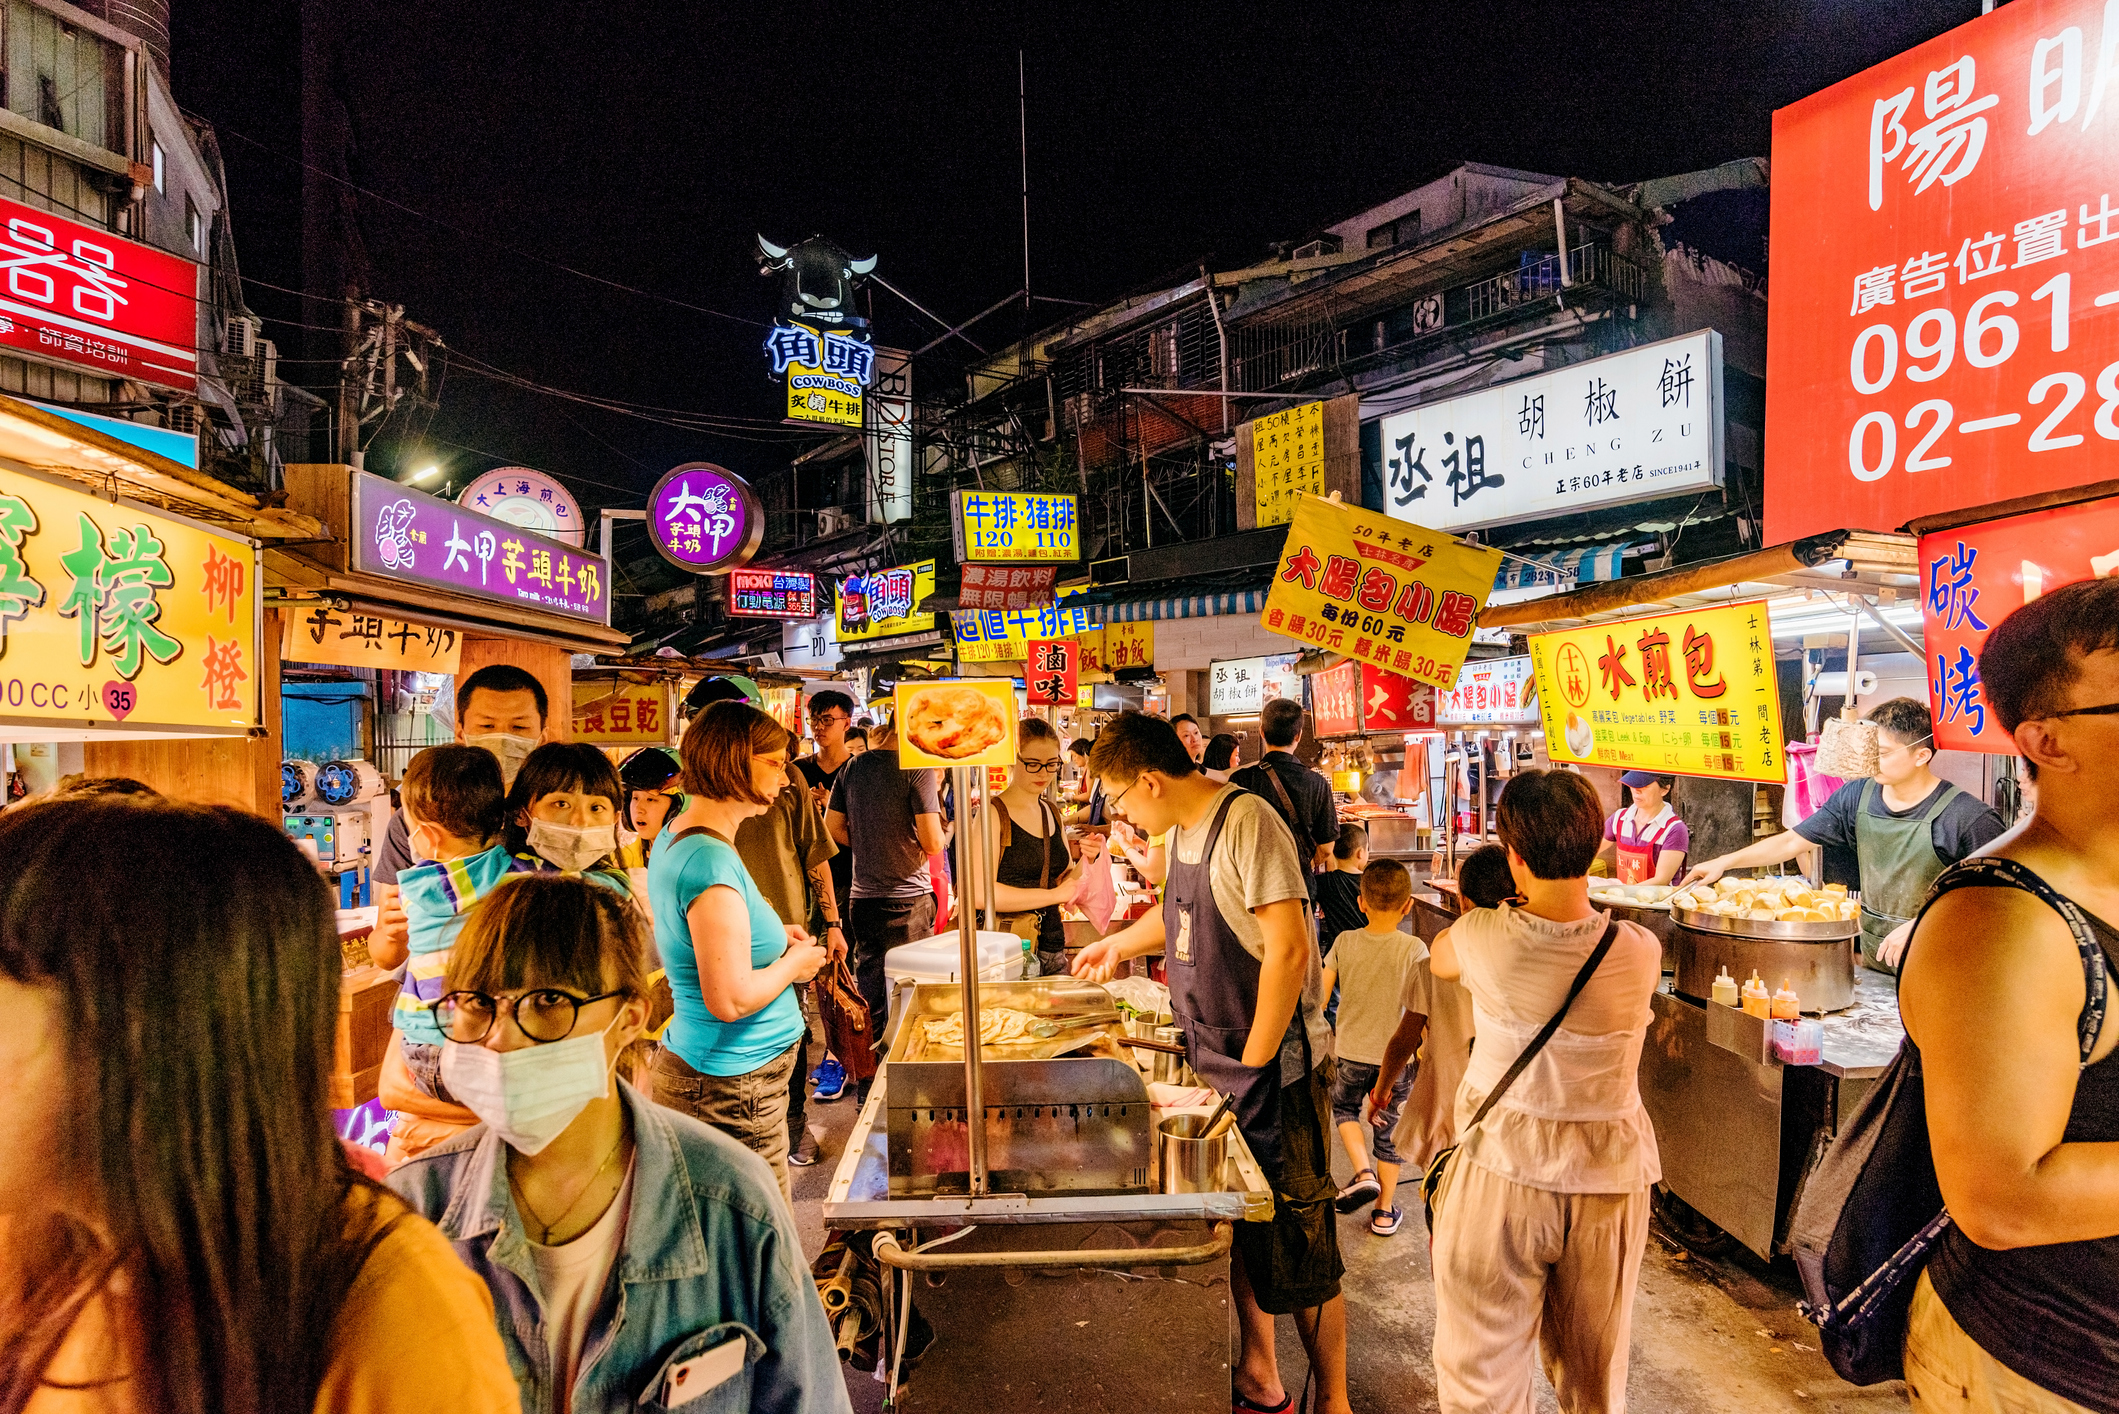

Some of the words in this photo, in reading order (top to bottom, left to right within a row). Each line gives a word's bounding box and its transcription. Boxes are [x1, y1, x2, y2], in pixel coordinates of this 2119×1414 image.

[767, 326, 874, 385] 角頭
[792, 374, 826, 389] COW
[826, 377, 862, 398] BOSS
[1518, 353, 1695, 441] 胡椒餅
[791, 390, 861, 417] 炙燒牛排
[879, 432, 897, 504] STORE
[1388, 431, 1506, 507] 丞祖
[1523, 437, 1622, 470] CHENG
[1555, 464, 1644, 494] 正宗60年老店
[475, 480, 569, 518] 大上海煎包
[664, 479, 736, 556] 大甲
[670, 521, 702, 538] 芋頭
[667, 538, 702, 554] 牛奶
[973, 530, 1014, 548] 120
[1034, 531, 1072, 548] 110
[1352, 524, 1435, 558] 50年老店
[867, 570, 912, 616] 角頭
[963, 565, 1052, 589] 濃湯飲料
[1281, 545, 1478, 638] 大腸包小腸
[736, 590, 786, 611] 行動電源
[200, 542, 249, 712] 柳橙
[1321, 602, 1406, 643] 每份60元
[1926, 540, 1990, 737] 碳烤
[812, 636, 826, 657] PD
[1112, 638, 1148, 666] 油飯
[1268, 608, 1345, 649] 香腸30元
[1352, 636, 1454, 685] 糯米腸30元
[1598, 623, 1727, 703] 水煎包
[1034, 643, 1073, 703] 滷味
[1215, 667, 1251, 684] 丞祖
[1562, 648, 1585, 702] 士林
[1747, 613, 1774, 767] 士林第一間老店
[0, 678, 69, 710] 0CC
[77, 682, 99, 712] 小
[109, 688, 132, 712] 35
[1212, 683, 1258, 701] 胡椒餅
[1450, 681, 1517, 711] 大腸包小腸
[572, 697, 660, 735] 食豆乾
[1621, 711, 1656, 724] Vegetables
[1659, 710, 1677, 724] 野菜
[1616, 730, 1631, 742] Leek
[1639, 731, 1651, 745] Egg
[1618, 750, 1635, 762] Meat
[1664, 752, 1681, 766] にく
